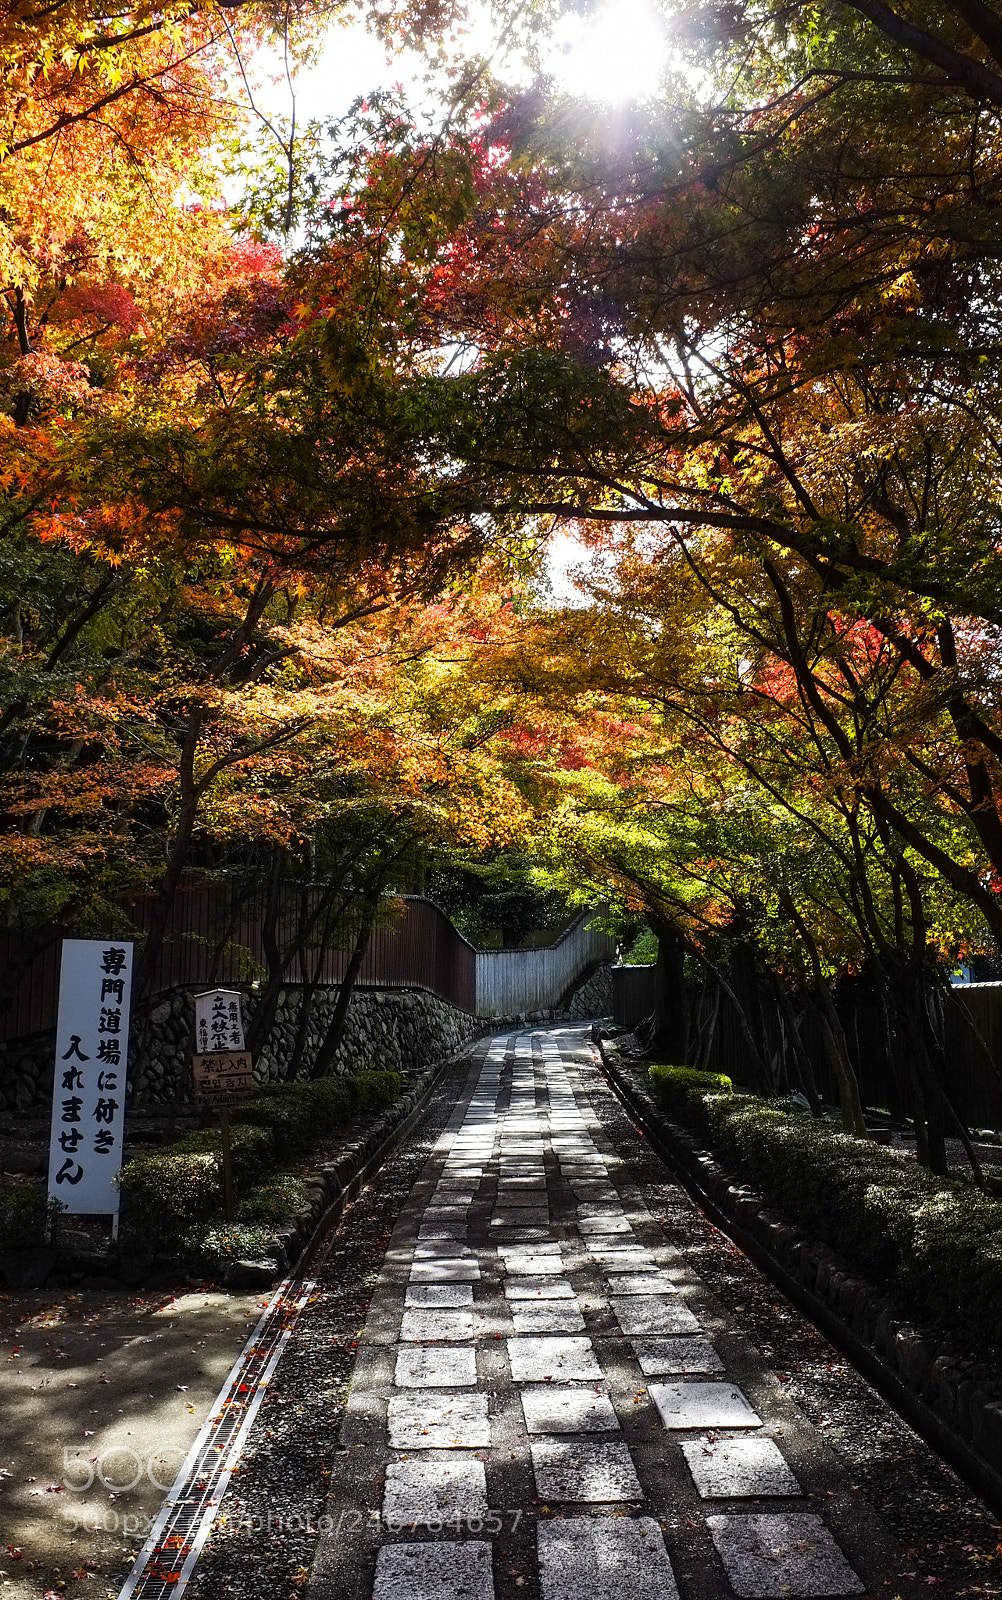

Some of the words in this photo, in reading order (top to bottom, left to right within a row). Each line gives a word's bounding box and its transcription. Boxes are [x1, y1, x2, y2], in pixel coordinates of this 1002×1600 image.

[92, 947, 128, 1154] 専門道場に付き
[200, 1057, 247, 1073] 禁止入内
[210, 995, 230, 1051] 立入禁止
[55, 1034, 91, 1186] 入れません
